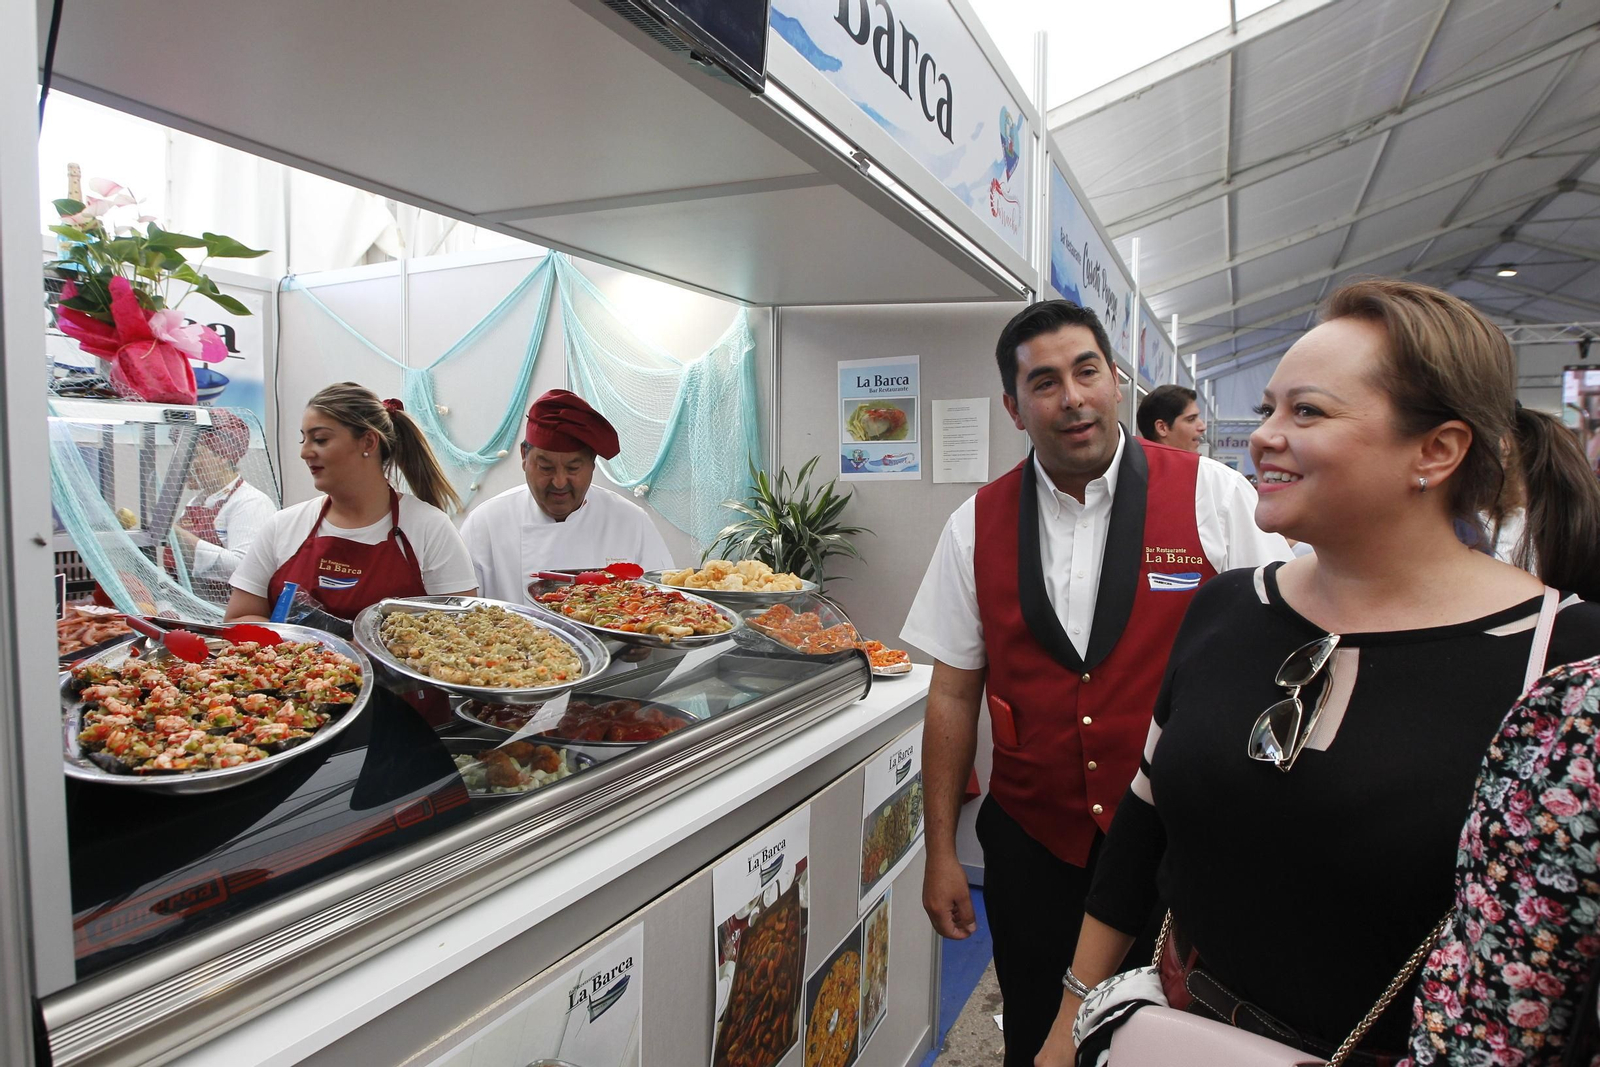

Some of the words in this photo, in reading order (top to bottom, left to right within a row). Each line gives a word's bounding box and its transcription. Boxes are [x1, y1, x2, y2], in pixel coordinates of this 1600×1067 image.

[856, 376, 870, 388] La
[874, 374, 910, 387] Barca
[1217, 436, 1250, 448] nfan
[1145, 552, 1162, 563] La
[1166, 552, 1203, 565] Barca
[318, 562, 331, 571] La
[334, 564, 362, 575] Barca
[889, 758, 897, 771] La
[897, 745, 914, 764] Barca
[748, 858, 760, 873] La
[762, 838, 786, 863] Barca
[568, 988, 588, 1011] La
[591, 956, 634, 993] Barca
